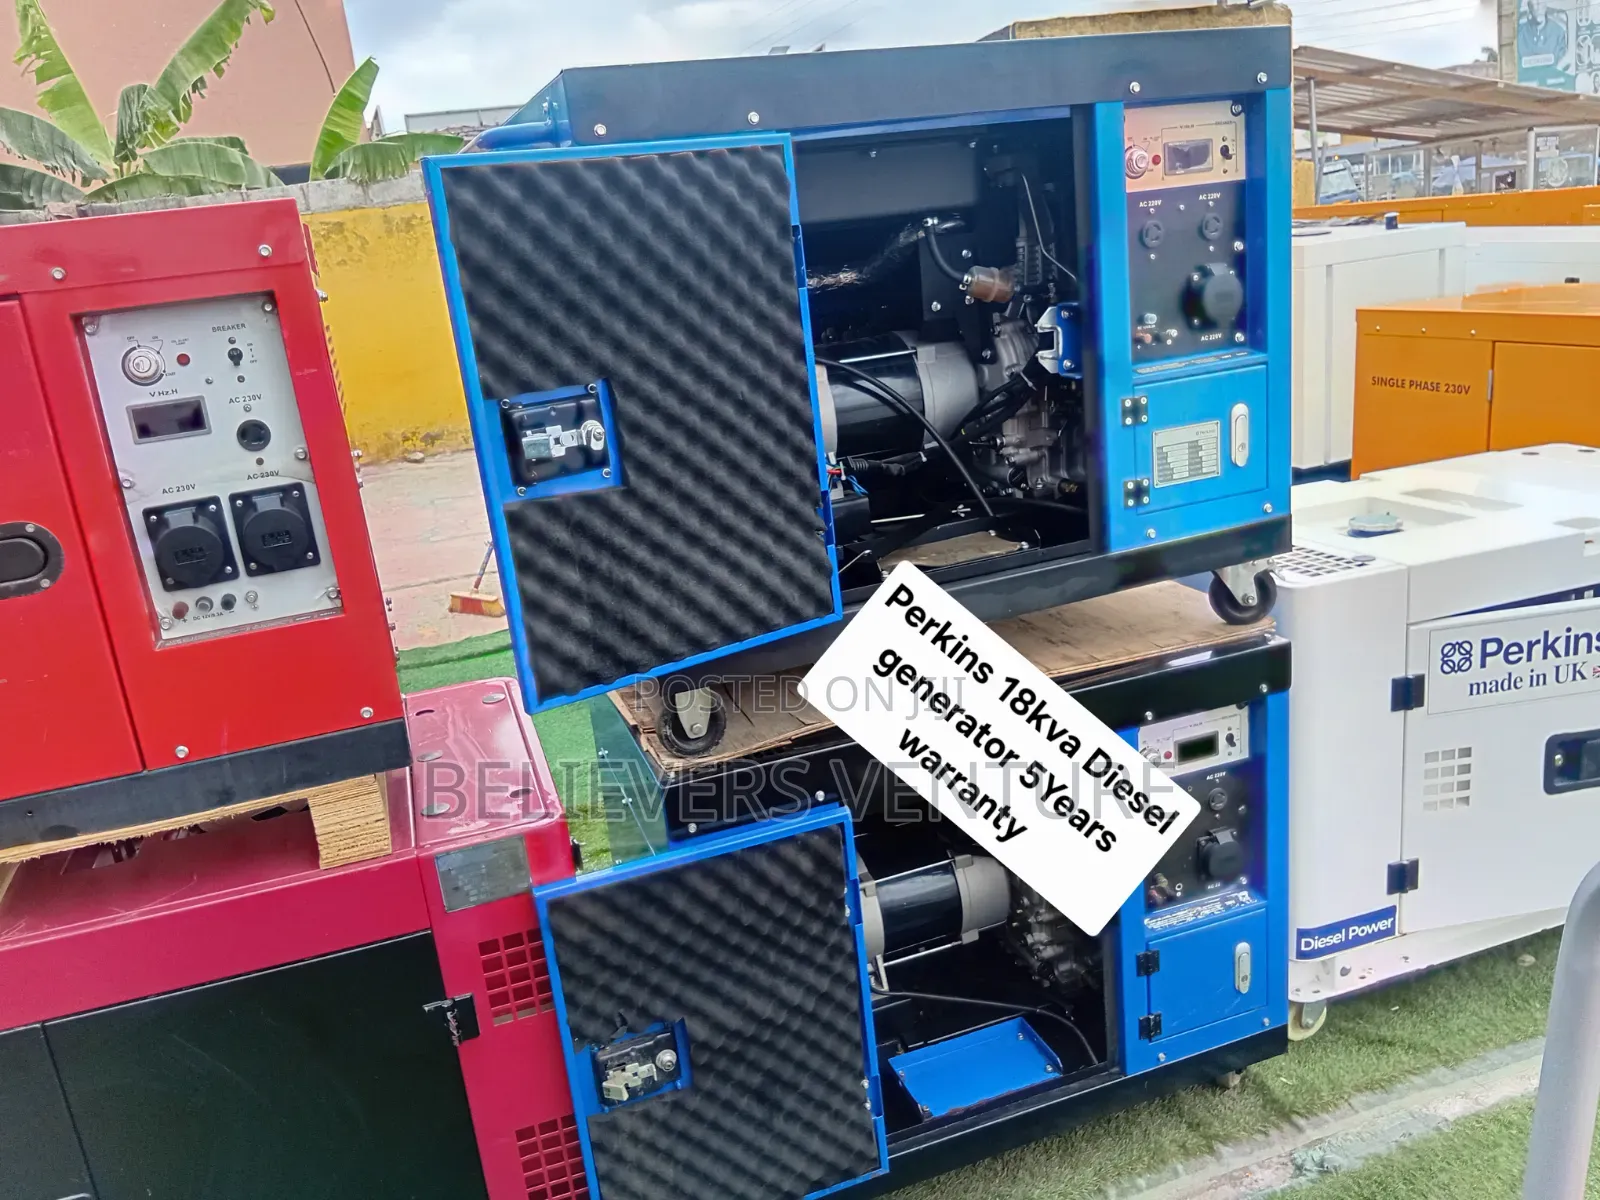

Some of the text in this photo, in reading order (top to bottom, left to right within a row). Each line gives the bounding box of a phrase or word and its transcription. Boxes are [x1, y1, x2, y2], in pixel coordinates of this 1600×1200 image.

[211, 323, 247, 333] BREAKER
[1200, 334, 1208, 342] AC
[1371, 376, 1471, 396] SINGLE PHASE 230V
[228, 393, 263, 405] AC 230V
[246, 469, 280, 481] AC 230V
[162, 483, 196, 495] AC 230V
[1479, 625, 1600, 670] Perkin
[1468, 660, 1588, 697] made in UK
[1300, 917, 1394, 951] Diesel Power
